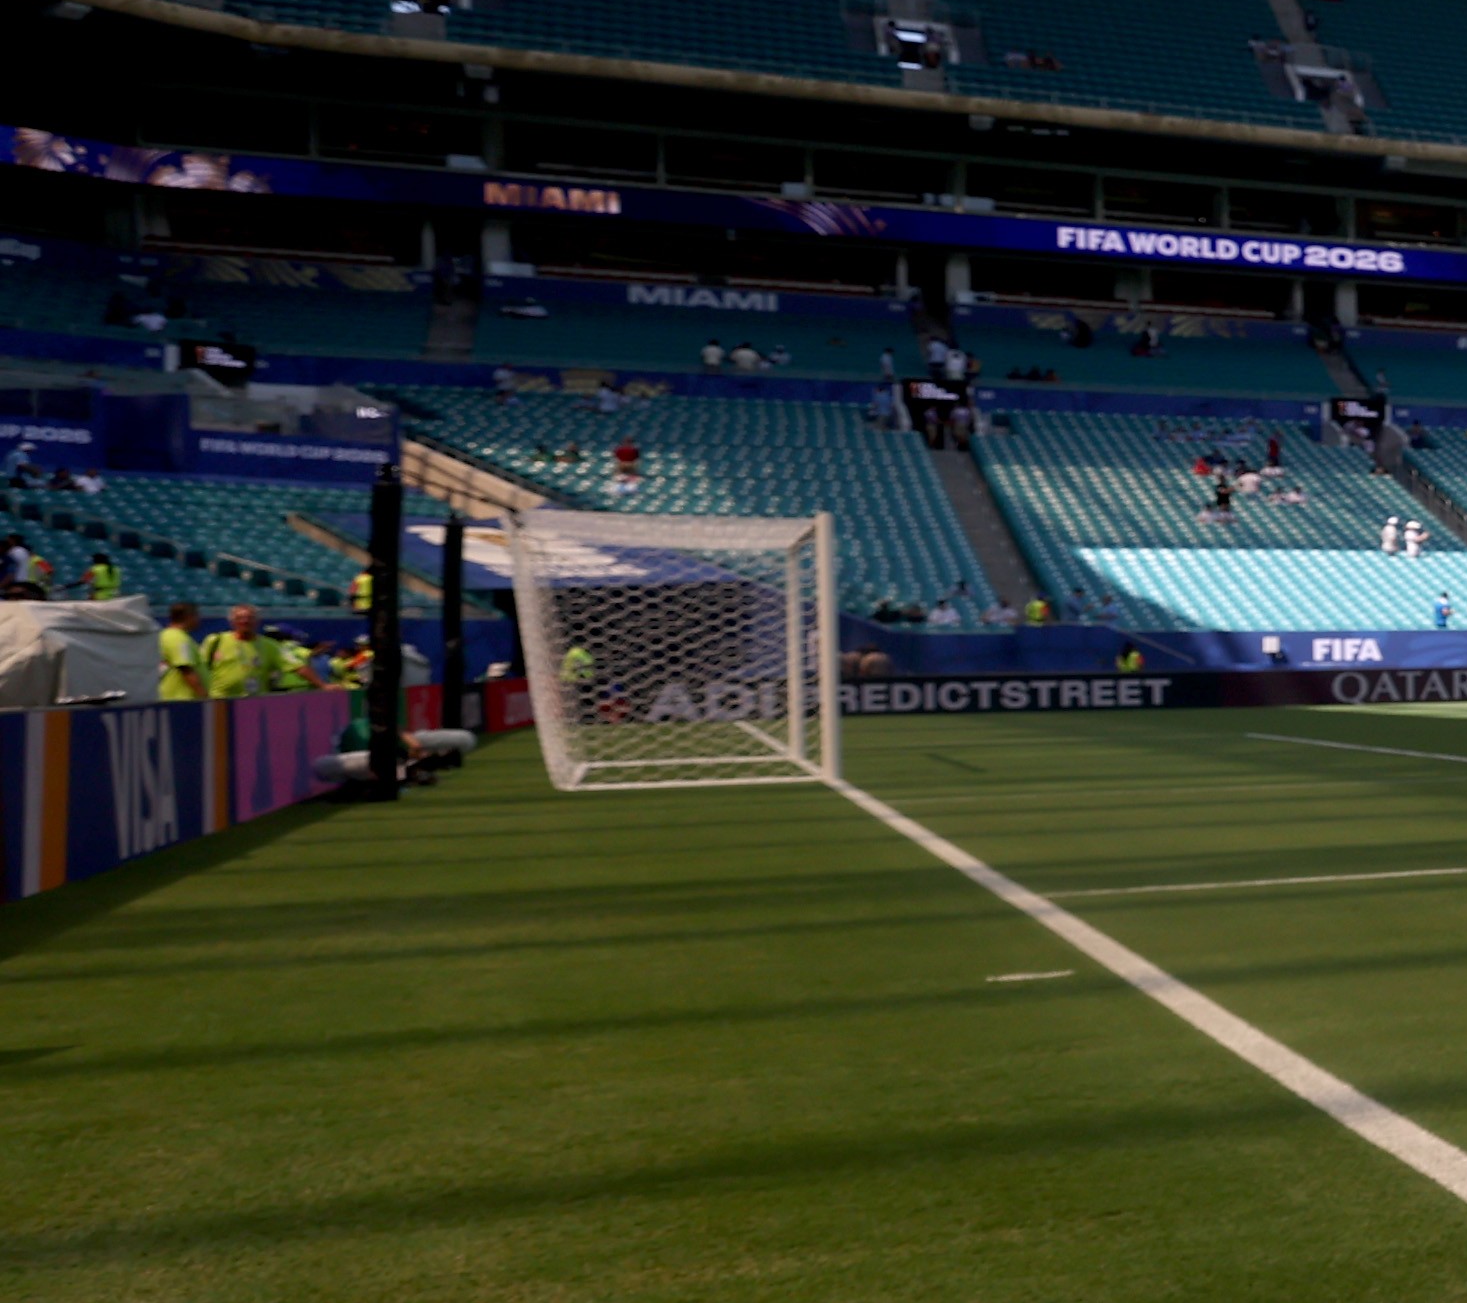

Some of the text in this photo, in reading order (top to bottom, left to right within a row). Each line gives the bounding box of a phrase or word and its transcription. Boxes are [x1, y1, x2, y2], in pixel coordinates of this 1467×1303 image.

[483, 181, 622, 215] MIAMI
[1056, 226, 1405, 273] FIFA WORLD CUP 2026
[627, 284, 779, 312] MIAMI
[1312, 638, 1383, 662] FIFA
[101, 708, 180, 860] VISA
